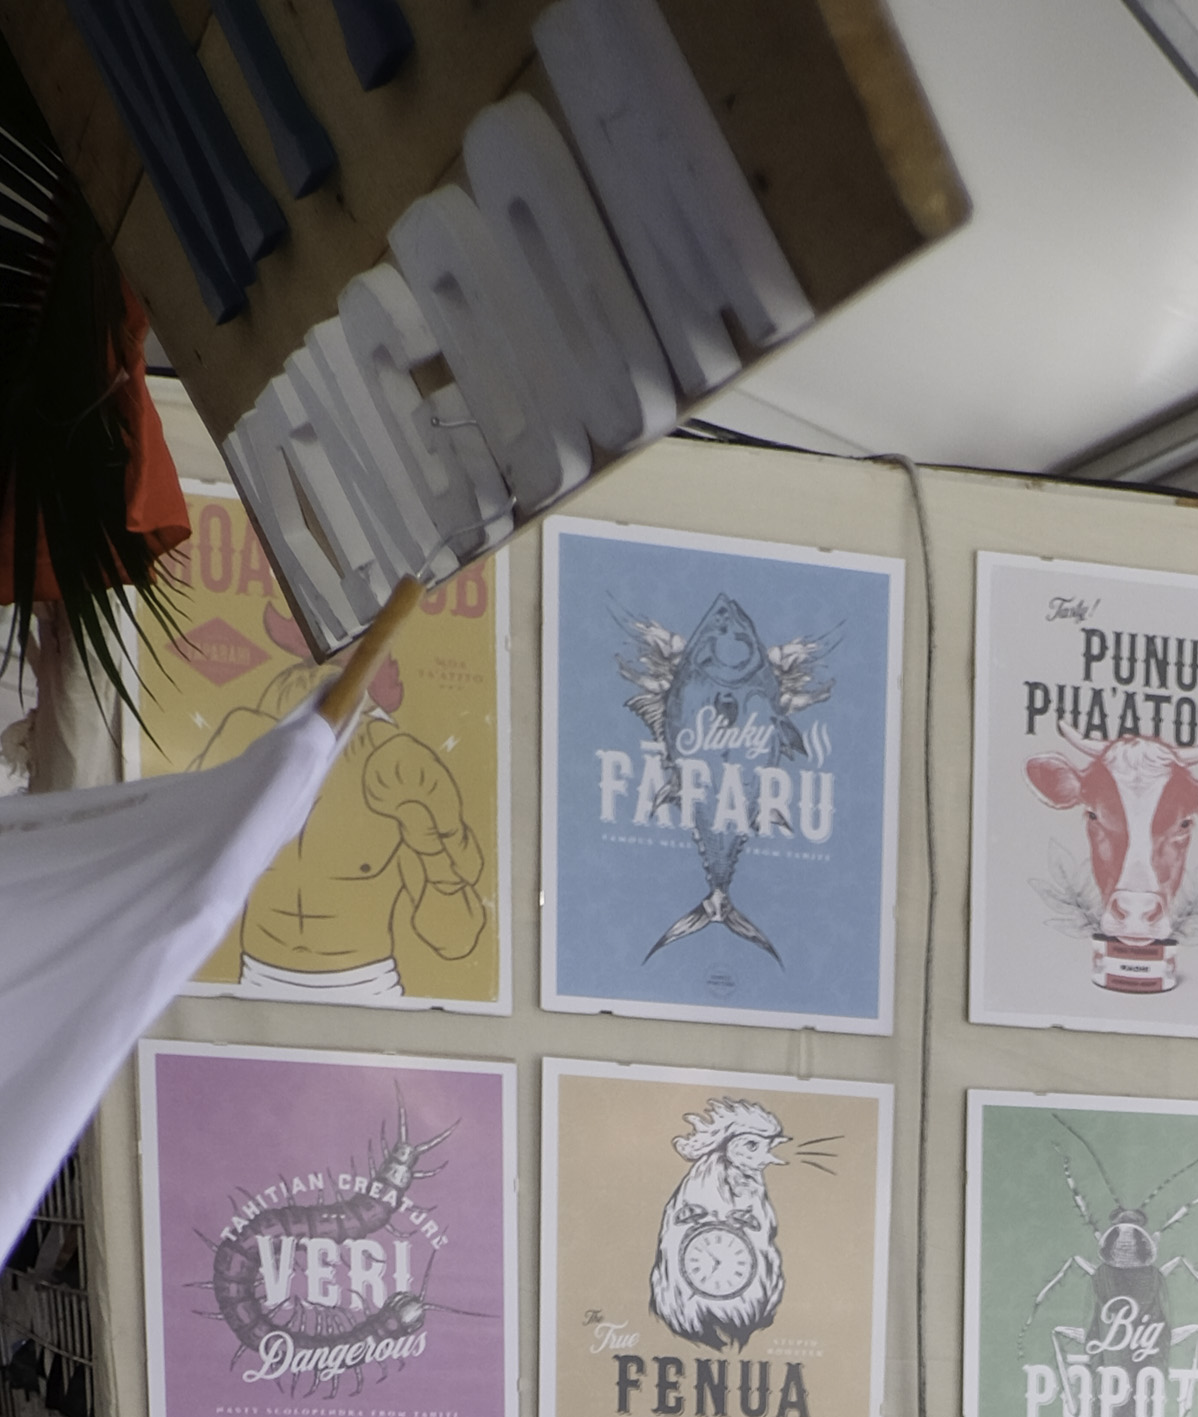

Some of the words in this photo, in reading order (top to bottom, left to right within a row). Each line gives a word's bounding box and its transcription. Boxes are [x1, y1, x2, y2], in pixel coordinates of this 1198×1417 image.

[1046, 596, 1101, 624] Tasty!
[676, 705, 776, 760] Stinky
[220, 1172, 325, 1243] TAHITIAN
[337, 1172, 448, 1252] CREATURE
[254, 1234, 414, 1313] VERI
[582, 1309, 604, 1327] The
[589, 1321, 639, 1354] True
[1086, 1295, 1165, 1364] Big
[242, 1329, 429, 1385] Dangerous
